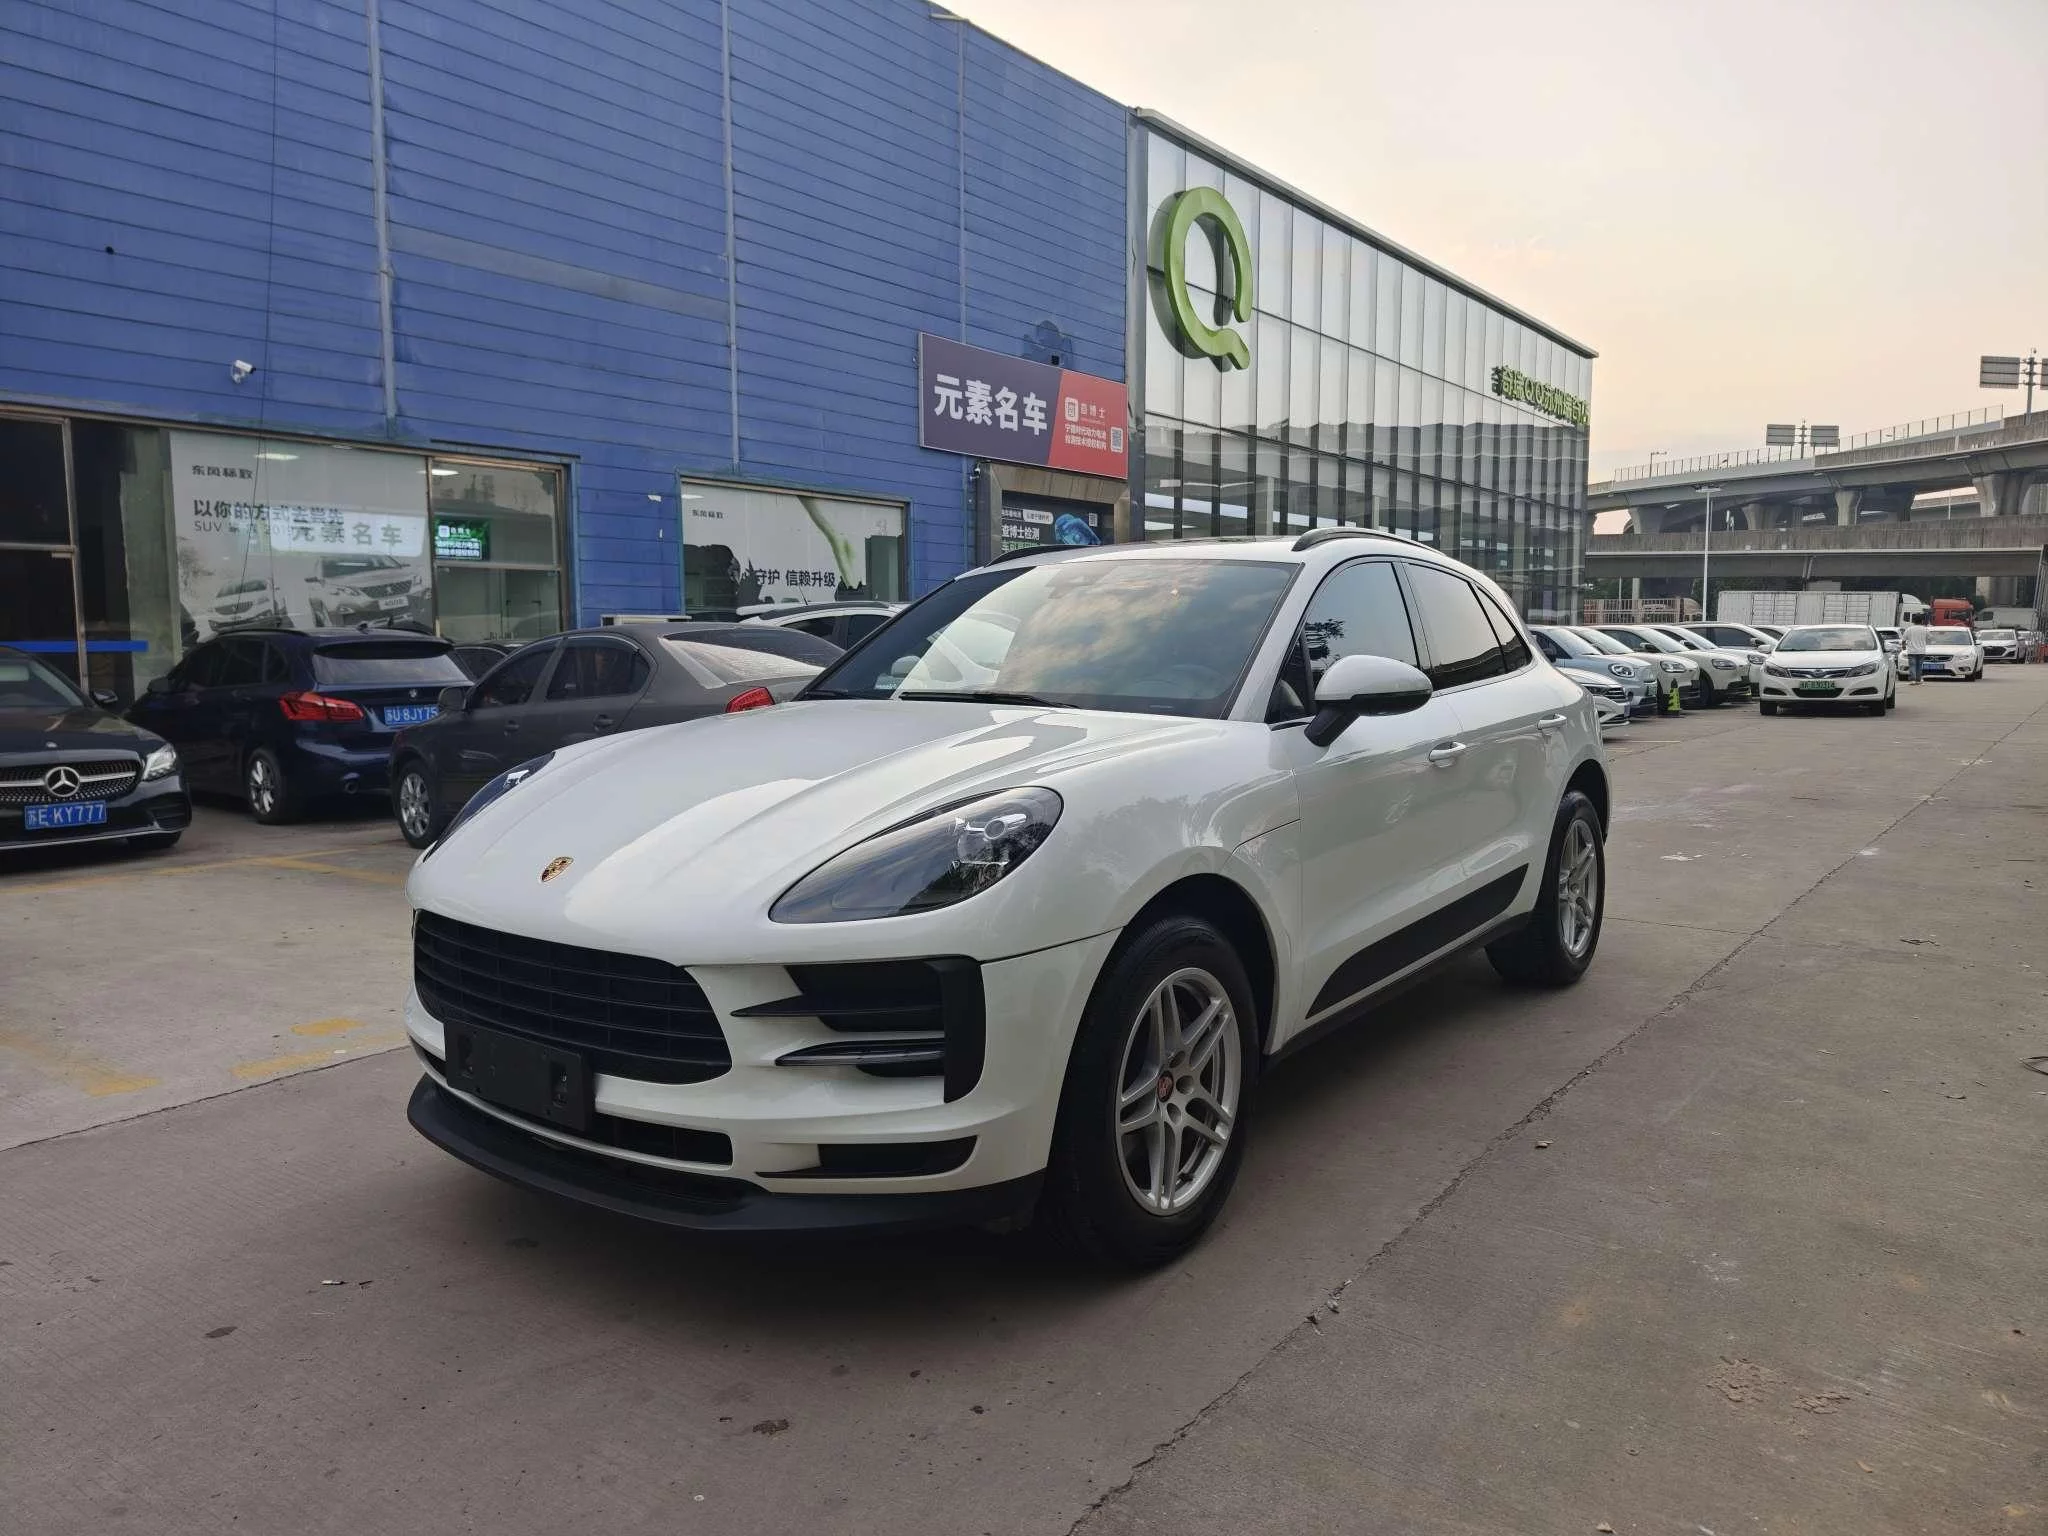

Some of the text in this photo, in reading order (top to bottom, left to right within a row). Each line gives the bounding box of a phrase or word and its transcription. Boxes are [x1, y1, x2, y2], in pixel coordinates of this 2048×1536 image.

[1164, 186, 1253, 370] Q
[934, 373, 1047, 436] 元素名车
[192, 464, 254, 480] 东风标致
[193, 521, 222, 533] SUV
[291, 520, 403, 547] 元素名车
[1002, 524, 1040, 540] 查博士检测
[785, 569, 836, 588] 信赖升级
